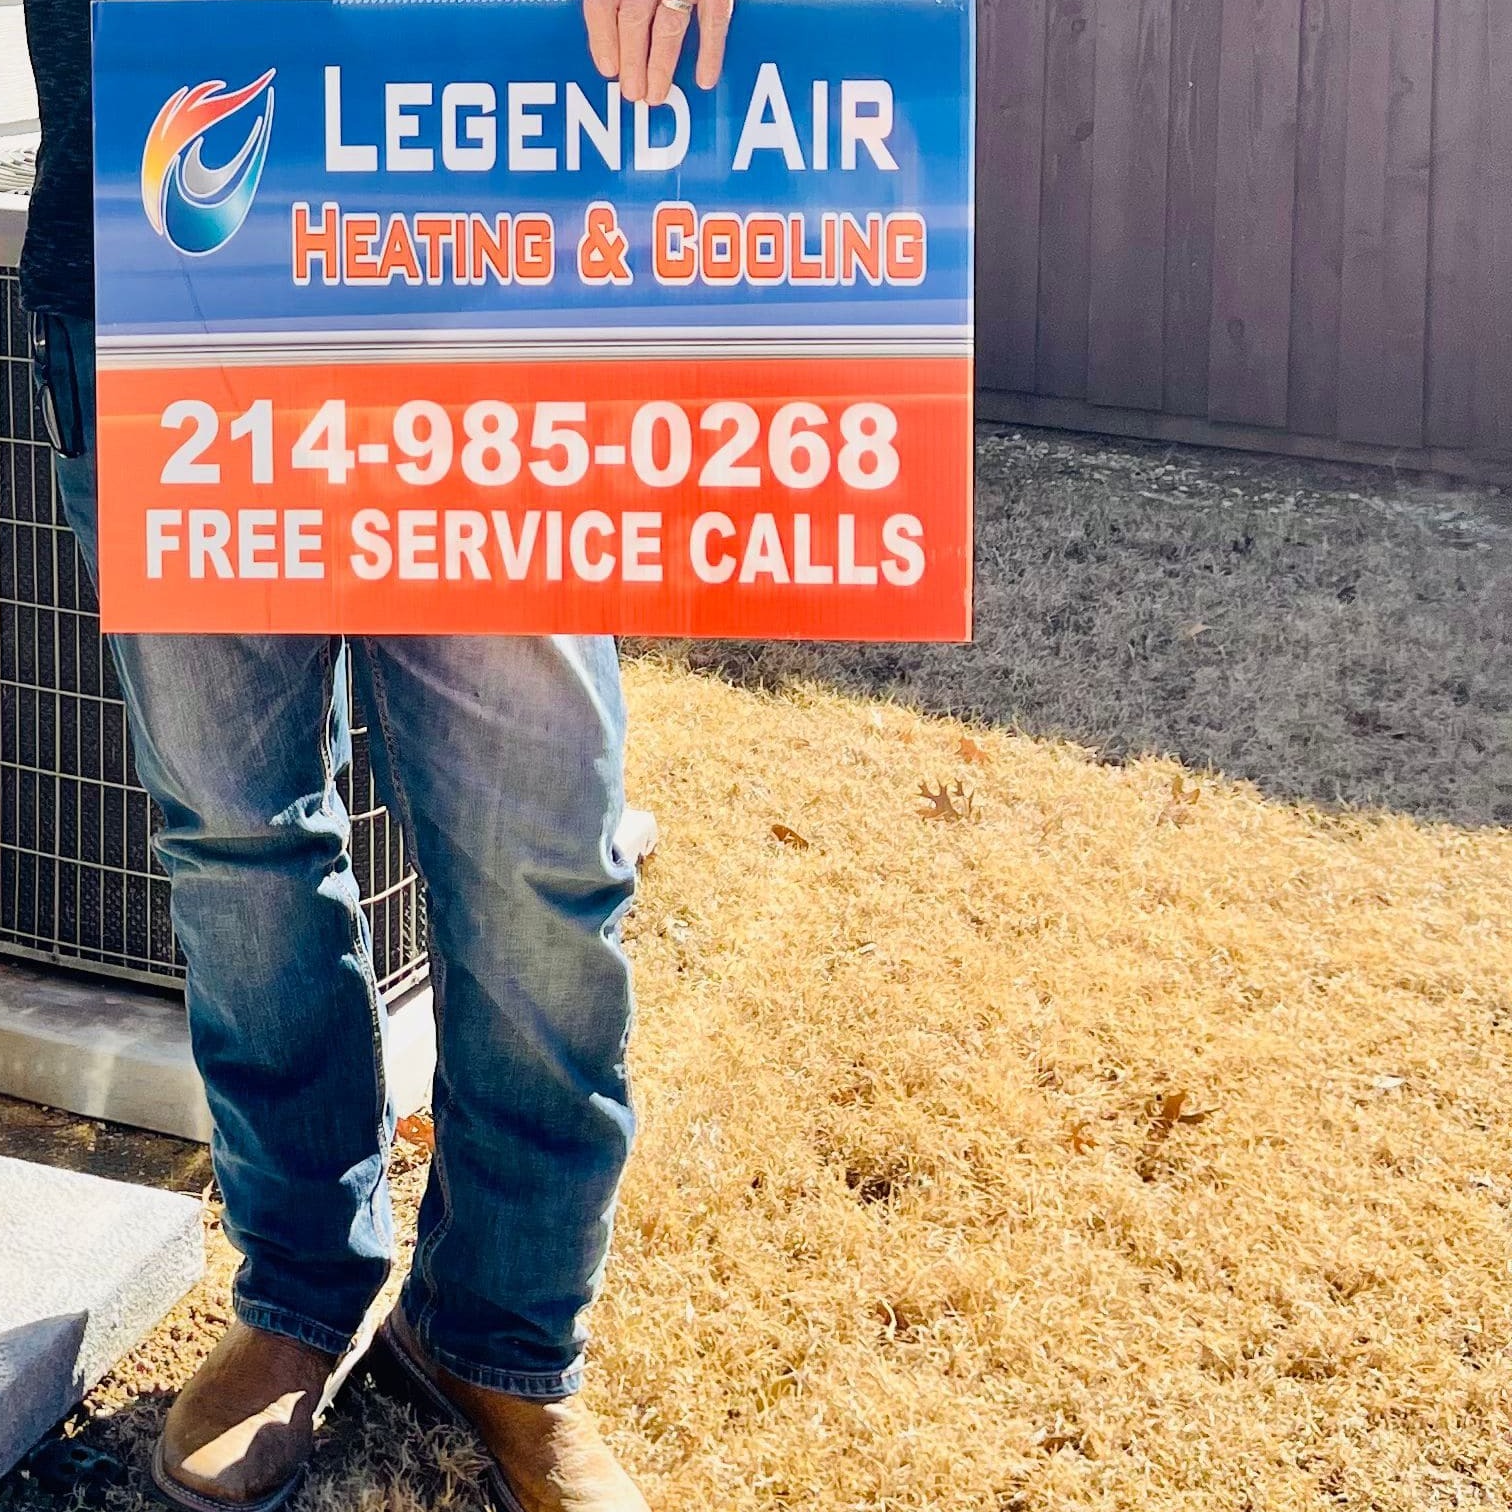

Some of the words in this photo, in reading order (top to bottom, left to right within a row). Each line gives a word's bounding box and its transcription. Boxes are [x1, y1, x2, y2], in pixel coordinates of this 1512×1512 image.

[324, 64, 691, 172] LEGEND
[731, 61, 900, 171] AIR
[292, 201, 555, 286] HEATING
[577, 201, 634, 286] &
[652, 201, 927, 286] COOLING
[158, 397, 902, 491] 214-985-0268
[144, 508, 325, 580] FREE
[349, 508, 664, 583] SERVICE
[691, 511, 927, 587] CALLS
